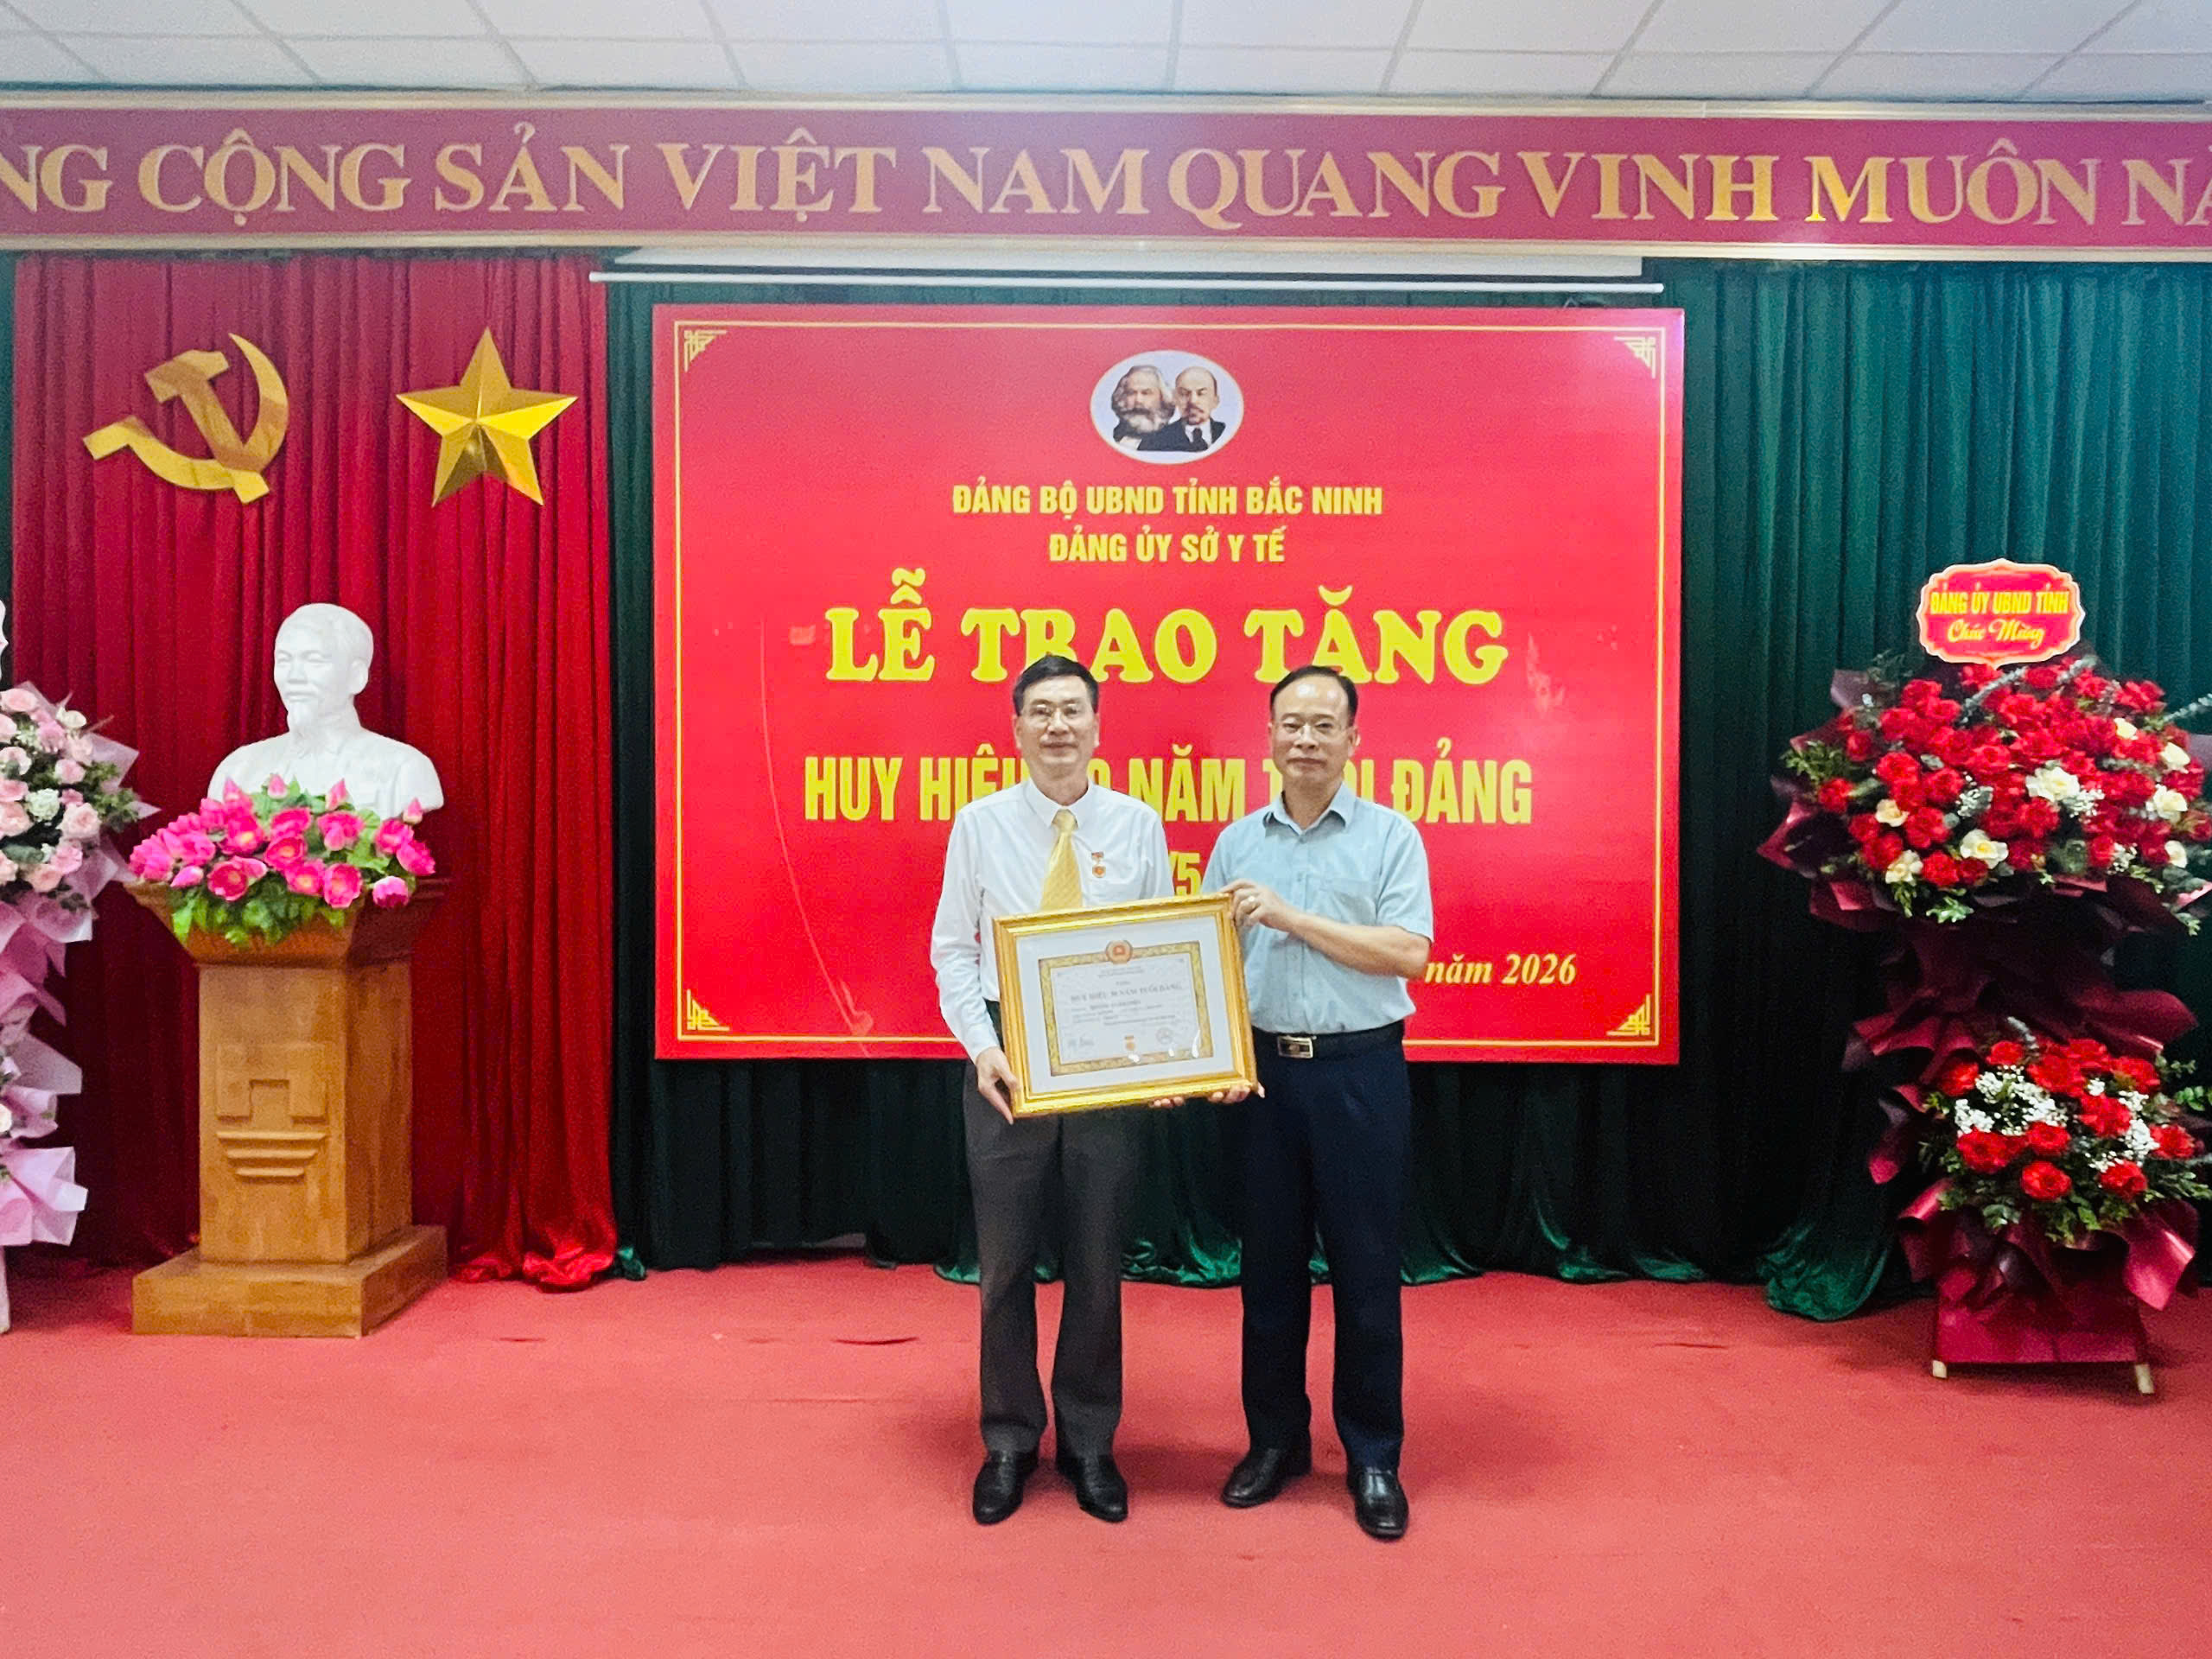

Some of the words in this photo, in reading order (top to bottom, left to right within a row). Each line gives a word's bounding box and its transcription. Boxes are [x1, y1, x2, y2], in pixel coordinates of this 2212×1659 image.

[137, 127, 412, 226] CỘNG
[435, 121, 631, 213] SẢN
[657, 127, 897, 223] VIỆT
[921, 147, 1151, 215] NAM
[1167, 148, 1506, 230] QUANG
[1516, 150, 1778, 223] VINH
[1804, 137, 2100, 226] MUÔN
[953, 476, 1031, 514] ĐẢNG
[1039, 480, 1077, 518] BỘ
[1086, 486, 1164, 514] UBND
[1173, 477, 1238, 514] TỈNH
[1246, 476, 1303, 514] BẮC
[1312, 487, 1383, 515] NINH
[1049, 525, 1128, 562] ĐẢNG
[1136, 525, 1172, 562] ỦY
[1180, 525, 1220, 562] SỞ
[1228, 534, 1244, 562] Y
[1253, 525, 1287, 562] TẾ
[1930, 582, 1968, 614] ĐẢNG
[1993, 591, 2032, 614] UBND
[2036, 582, 2070, 614] TỈNH
[825, 568, 936, 683] LỄ
[960, 607, 1217, 683] TRAO
[1243, 585, 1509, 684] TĂNG
[1948, 619, 1986, 643] Chúc
[1988, 619, 2046, 650] Mừng
[804, 757, 903, 821] HUY
[1128, 744, 1246, 823] NĂM
[1390, 737, 1533, 824] ĐẢNG
[1426, 954, 1493, 984] năm
[1502, 954, 1577, 984] 2026
